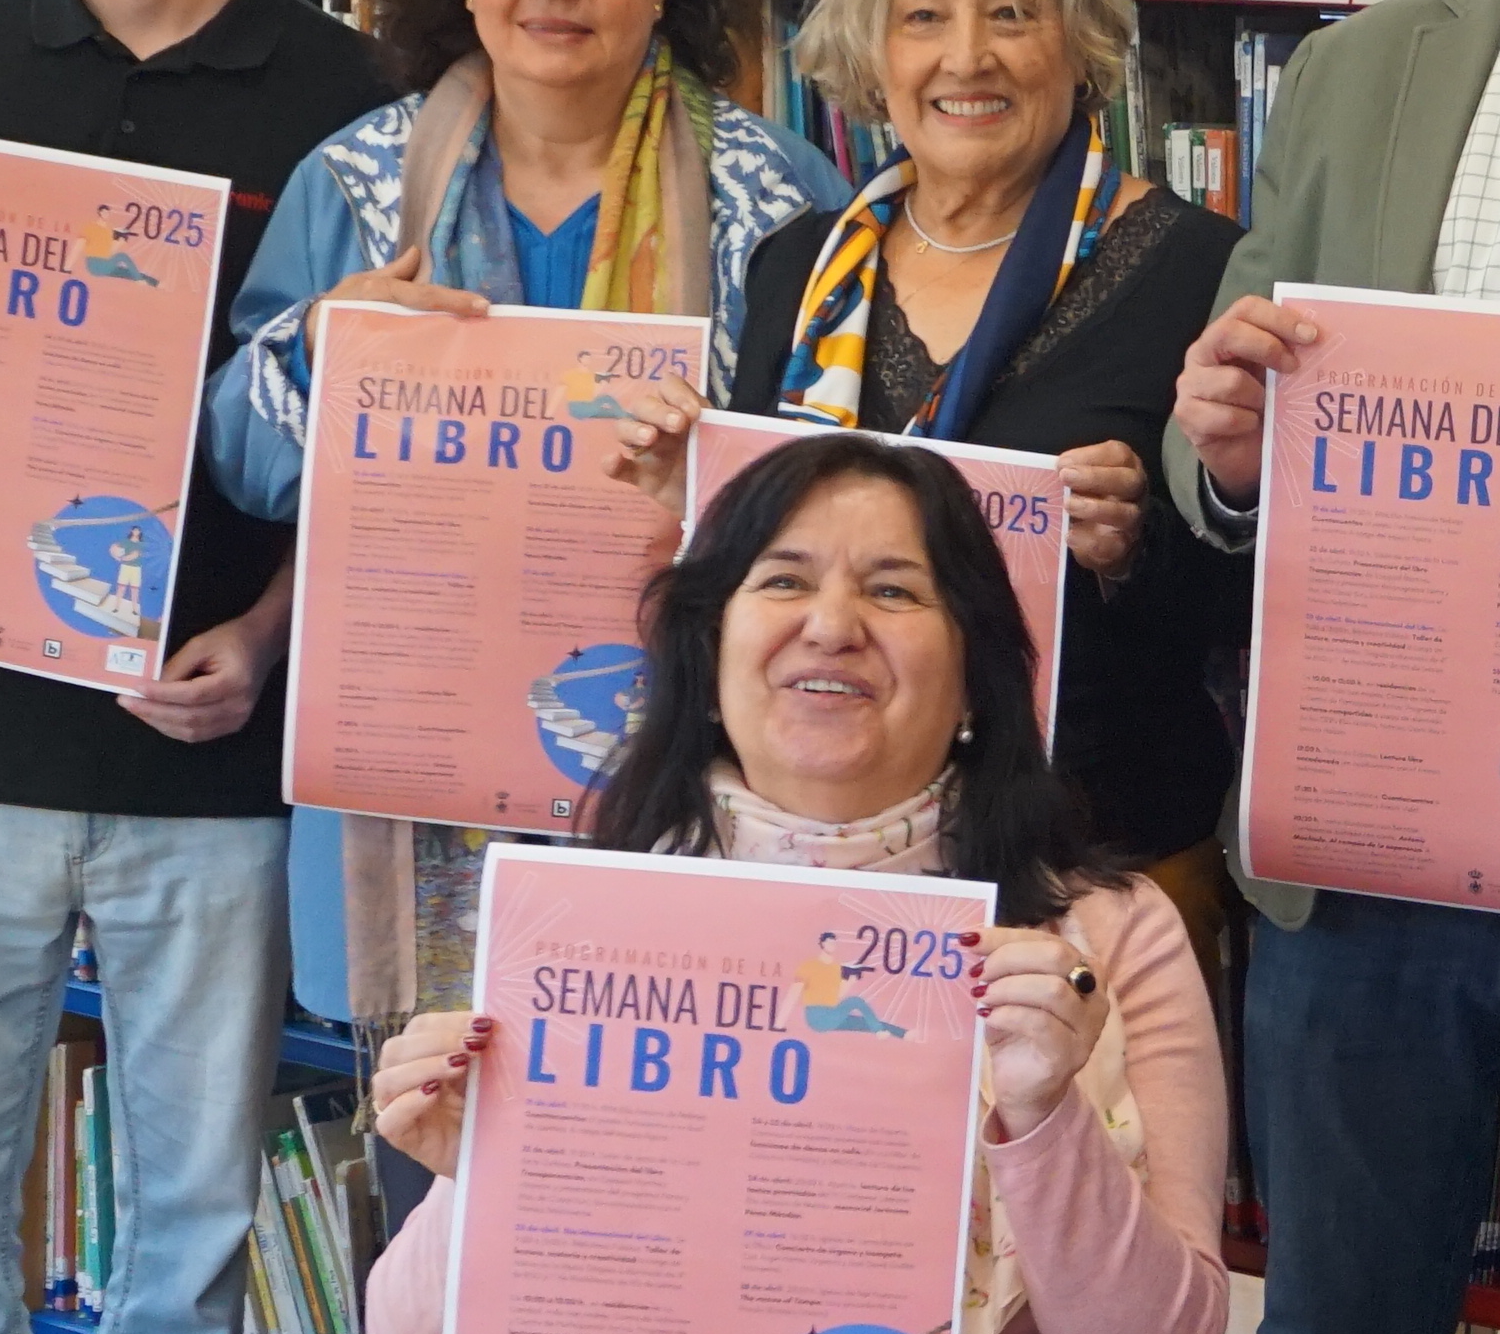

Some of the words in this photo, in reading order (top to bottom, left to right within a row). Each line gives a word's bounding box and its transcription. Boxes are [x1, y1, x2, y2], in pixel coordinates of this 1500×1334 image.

[125, 202, 206, 249] 2025
[20, 232, 73, 275] DEL
[605, 345, 690, 382] 2025
[356, 375, 488, 418] SEMANA
[499, 384, 555, 421] DEL
[1475, 381, 1496, 399] DE
[1314, 390, 1457, 444] SEMANA
[352, 412, 574, 474] LIBRO
[721, 956, 746, 976] DE
[758, 959, 783, 978] LA
[856, 924, 965, 981] 2025
[531, 964, 700, 1027] SEMANA
[714, 981, 788, 1033] DEL
[525, 1017, 811, 1105] LIBRO
